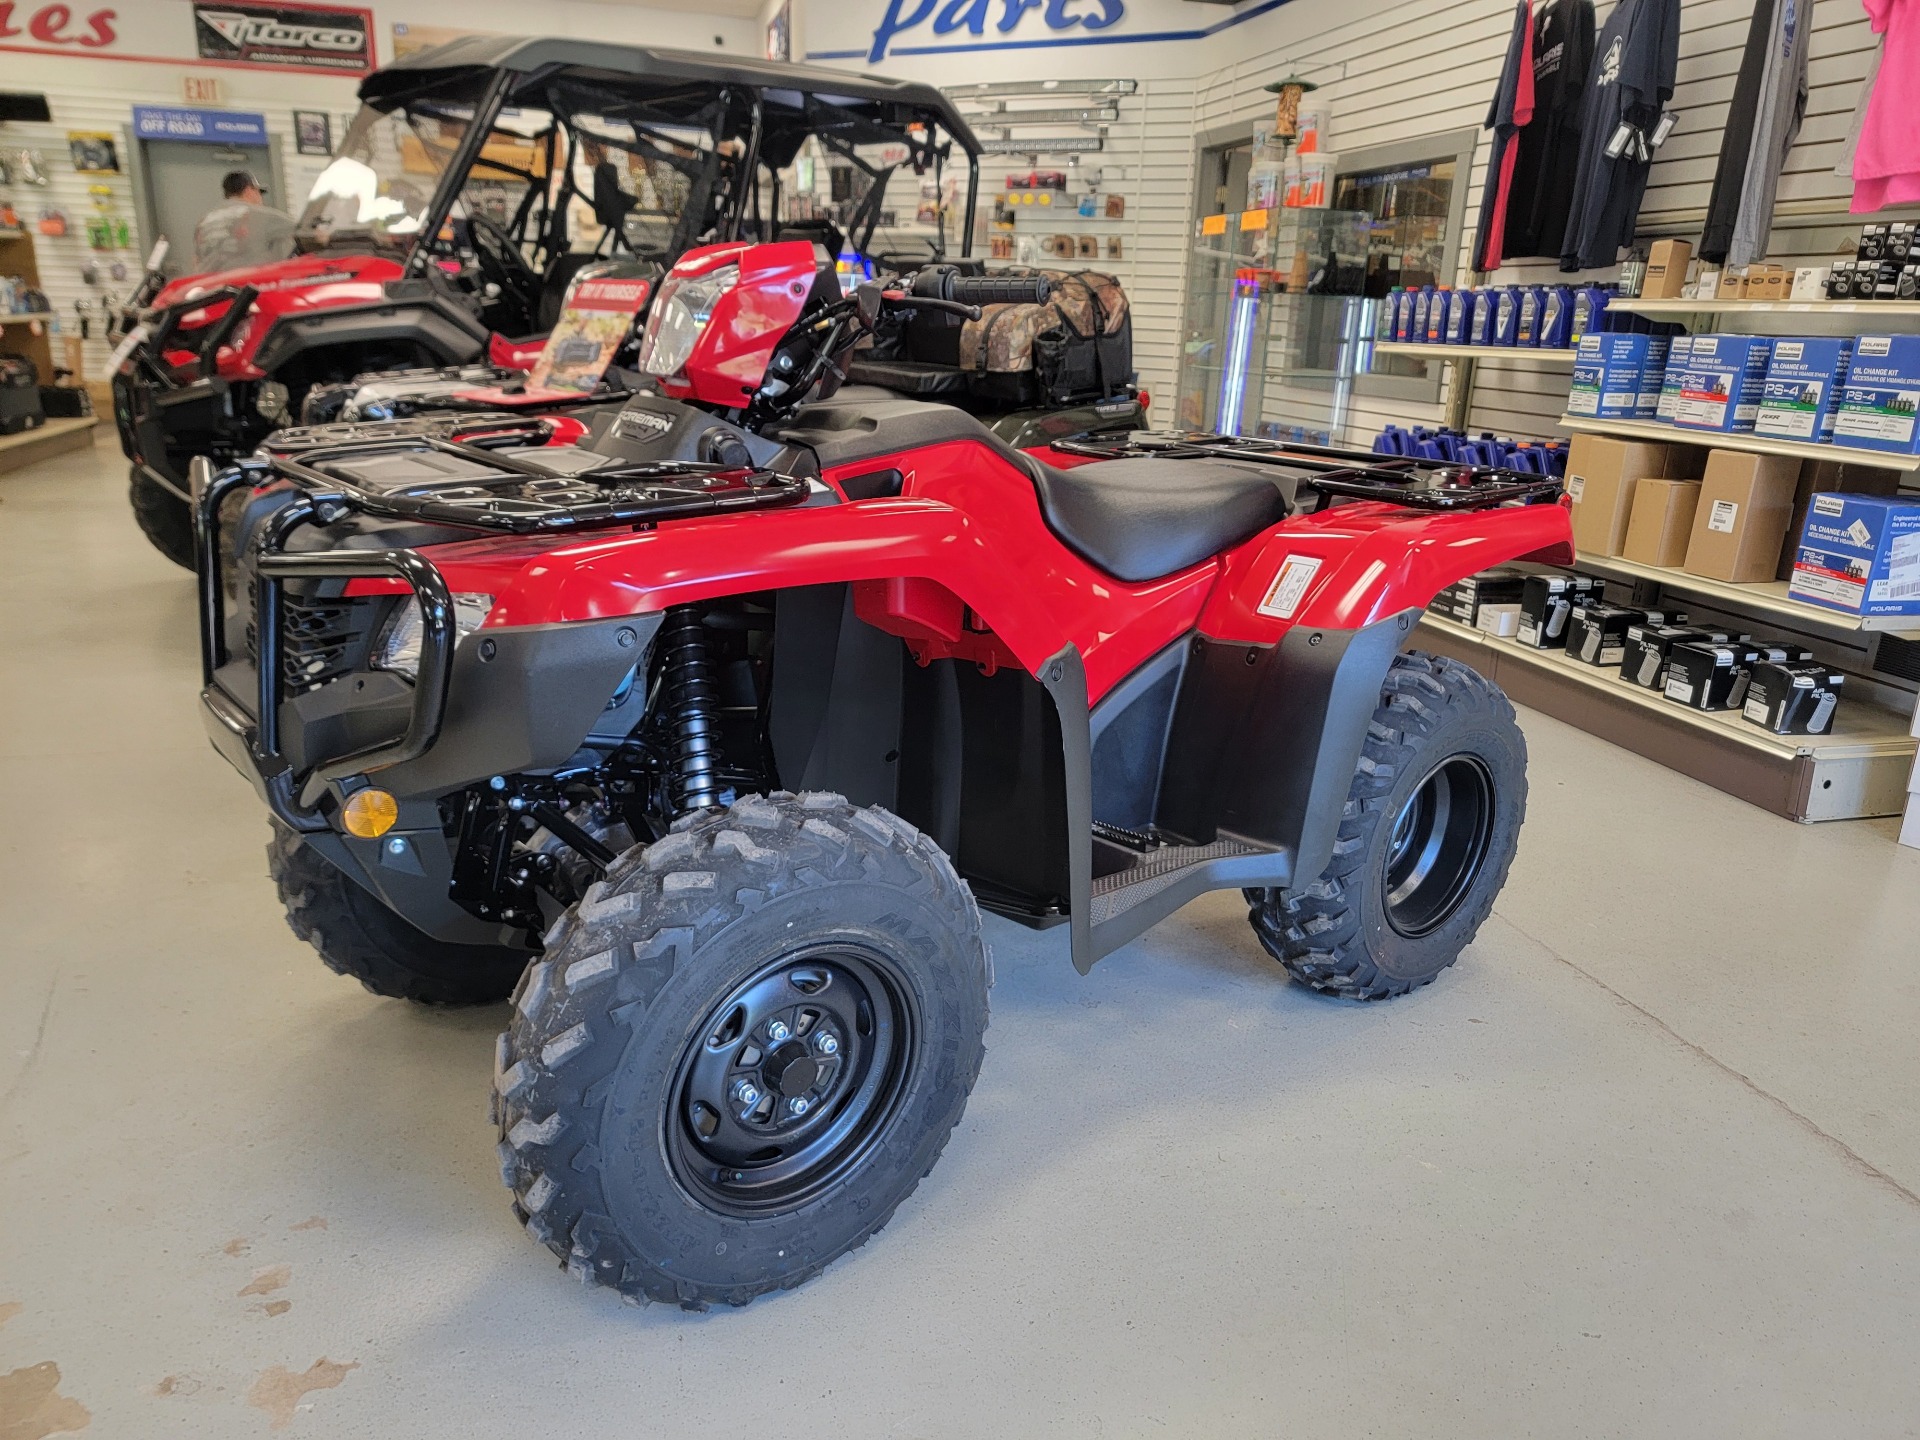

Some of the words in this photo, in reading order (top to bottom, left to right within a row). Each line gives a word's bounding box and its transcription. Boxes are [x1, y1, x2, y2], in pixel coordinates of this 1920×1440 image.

[230, 15, 365, 51] Torco
[1533, 42, 1564, 71] OLARIS
[184, 77, 218, 101] EXIT
[140, 119, 165, 132] OFF
[167, 120, 205, 136] ROAD
[1574, 371, 1594, 380] PS-4
[1666, 374, 1686, 382] PS-4
[1684, 374, 1706, 384] PS-4
[1764, 383, 1799, 396] PS-4
[1846, 390, 1876, 402] PS-4
[620, 410, 673, 432] FOREMAN
[1816, 499, 1842, 508] POLARIS
[1809, 523, 1818, 532] OIL
[1818, 525, 1841, 536] CHANGE
[1841, 530, 1850, 538] KIT
[1803, 551, 1825, 561] PS-4
[1583, 619, 1600, 628] FILTRE
[1640, 641, 1659, 651] FILTRE
[870, 911, 961, 1088] MAXXIS
